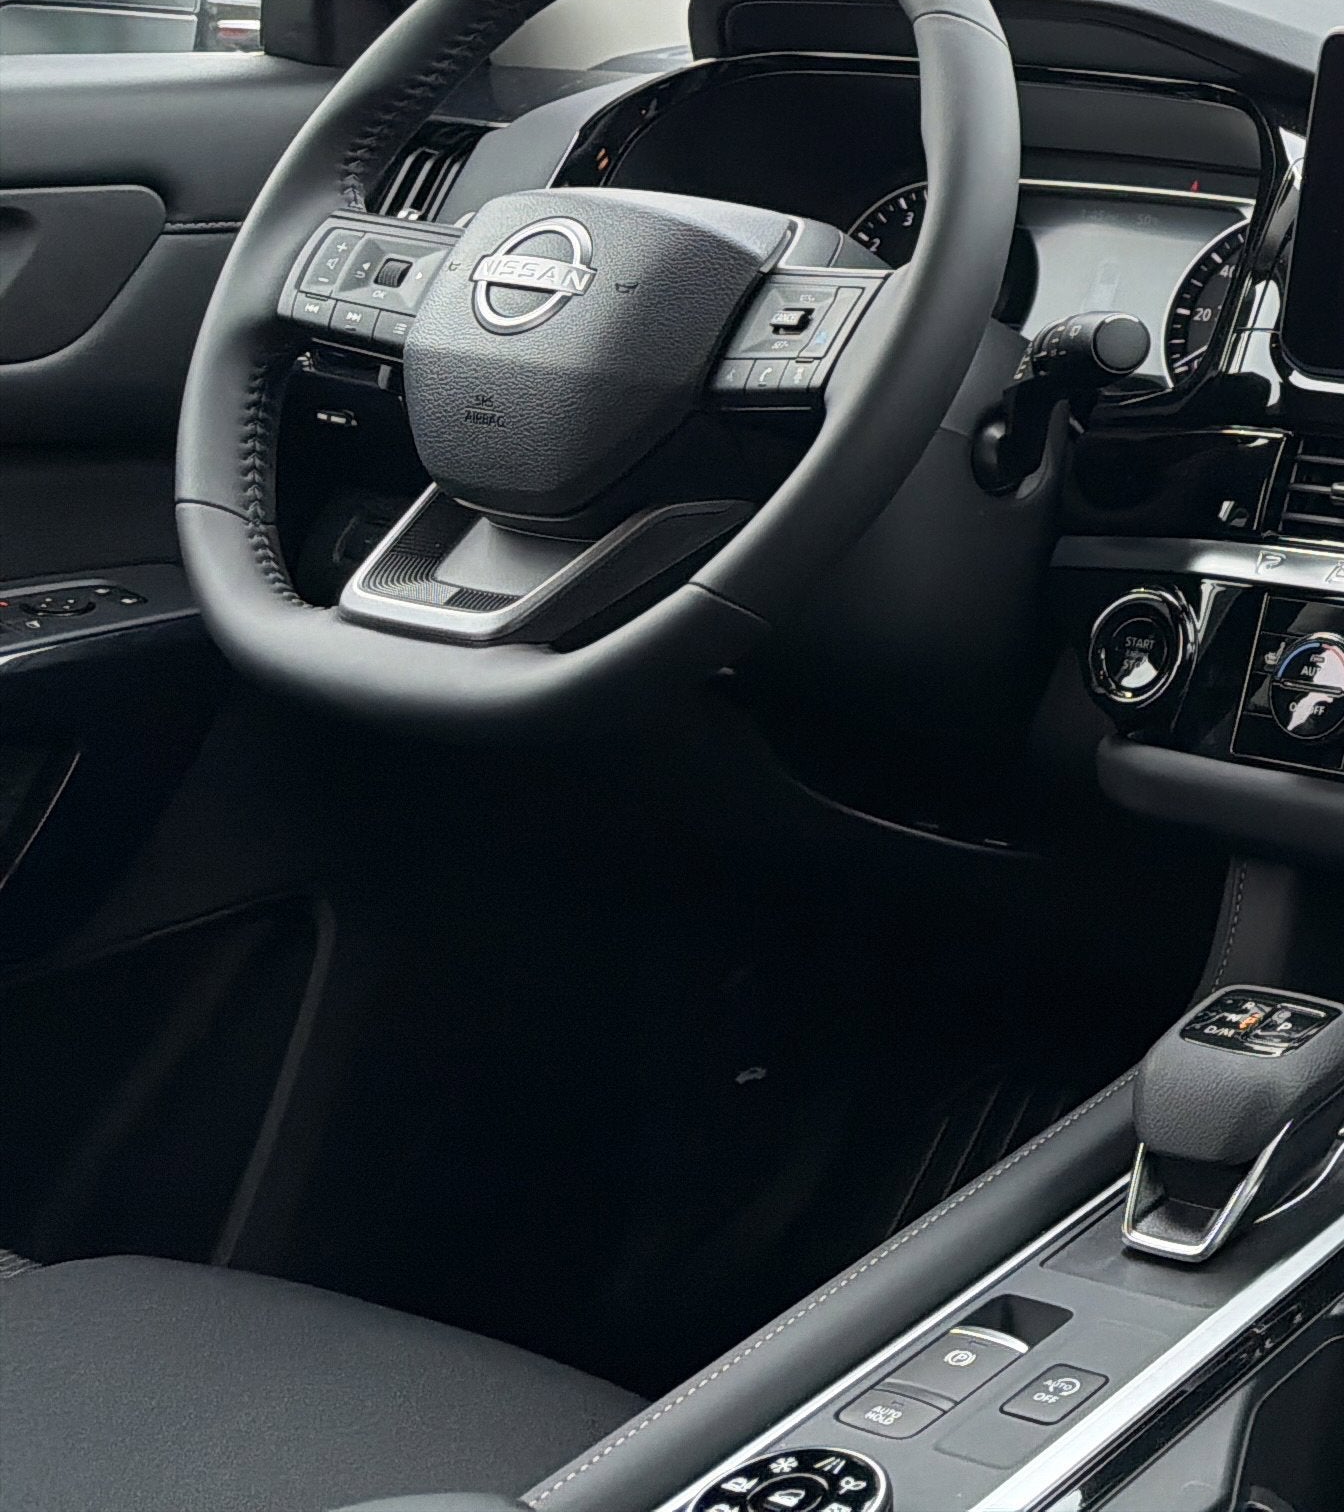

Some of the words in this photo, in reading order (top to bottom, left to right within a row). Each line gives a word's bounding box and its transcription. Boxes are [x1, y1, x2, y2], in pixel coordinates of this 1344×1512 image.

[902, 212, 915, 227] 3
[868, 237, 880, 252] 2
[483, 259, 591, 292] NISSAN
[1193, 308, 1212, 322] 20
[1125, 636, 1154, 649] START
[1034, 1392, 1060, 1404] OFF
[864, 1412, 896, 1426] HOLD
[874, 1406, 902, 1418] AUTO
